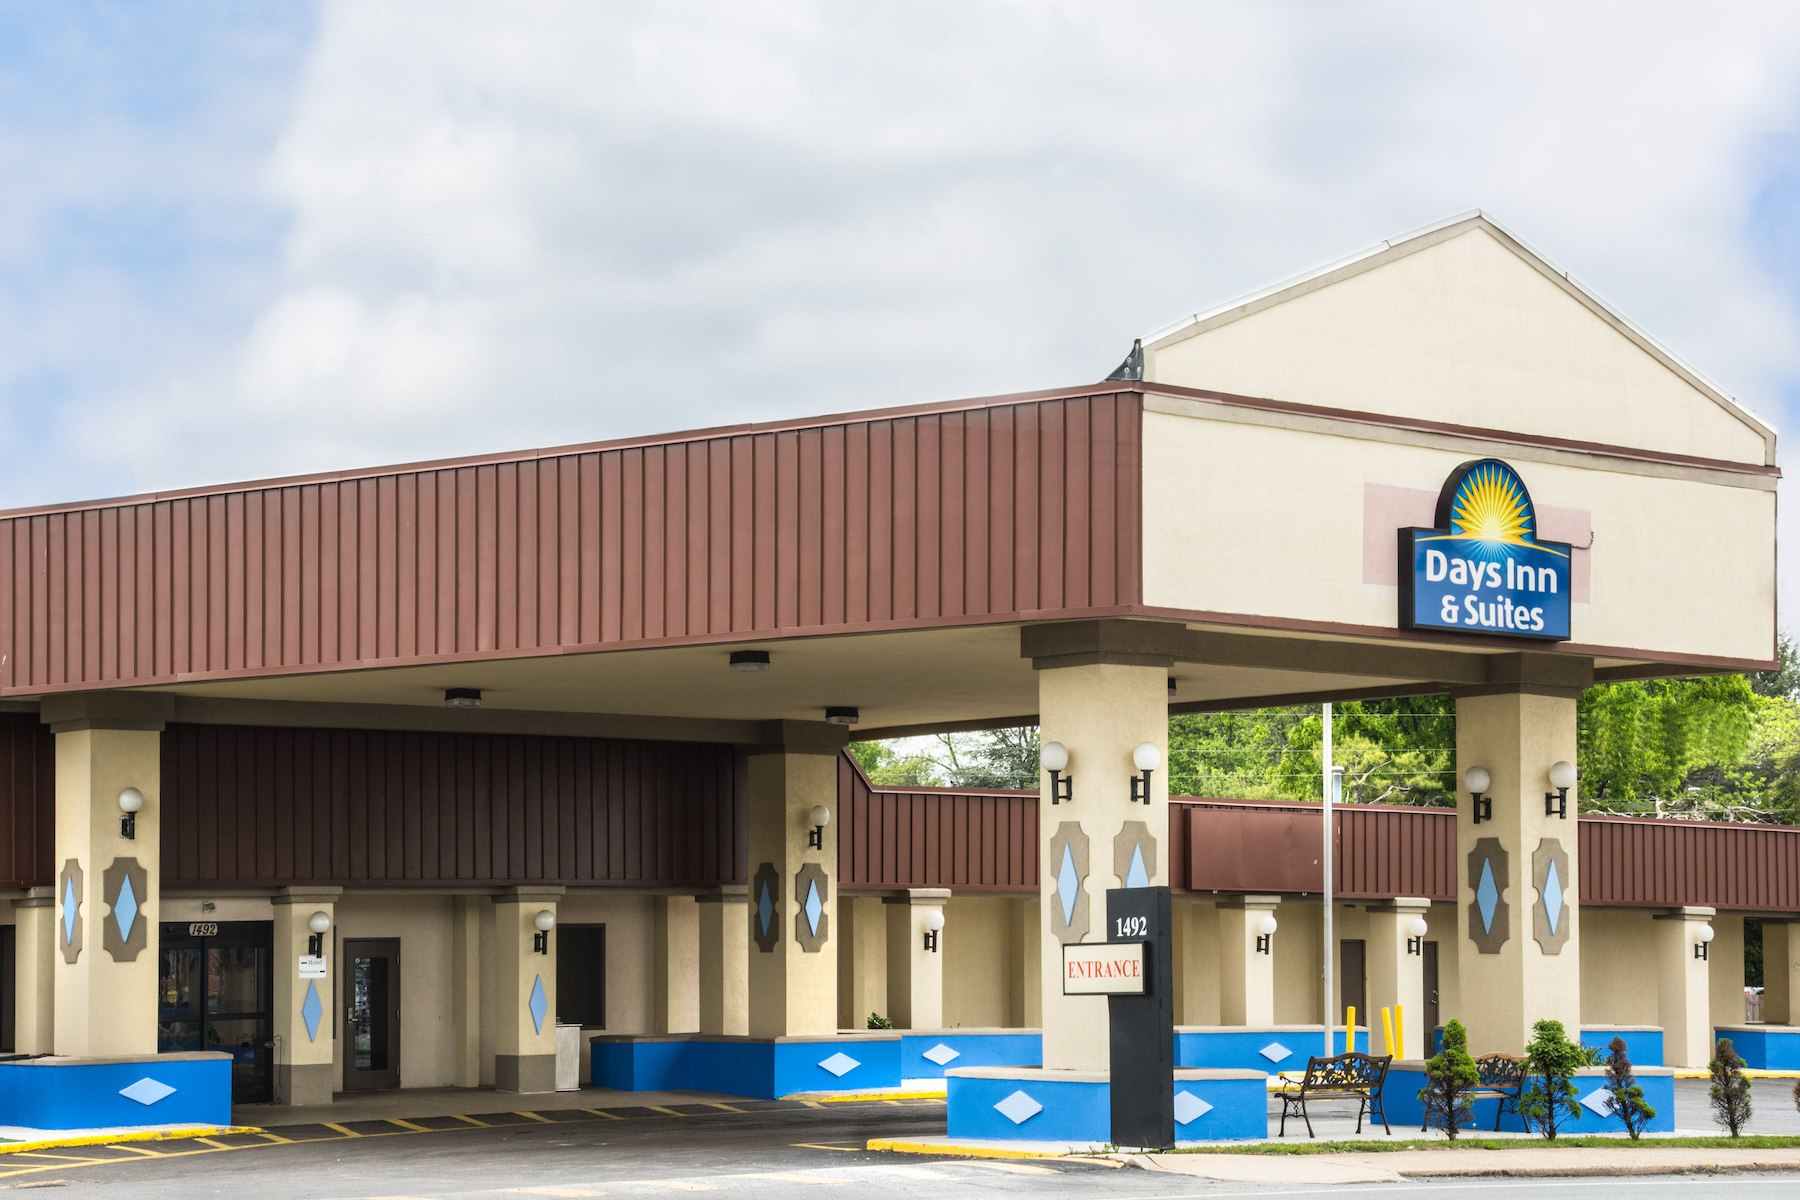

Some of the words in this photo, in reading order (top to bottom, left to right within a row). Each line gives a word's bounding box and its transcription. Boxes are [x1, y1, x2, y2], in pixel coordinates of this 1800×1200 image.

[1426, 549, 1502, 591] Days
[1506, 557, 1558, 593] Inn
[1440, 594, 1460, 624] &
[1464, 594, 1545, 631] Suites
[192, 923, 217, 936] 1492
[1116, 916, 1147, 937] 1492
[1068, 959, 1140, 978] ENTRANCE
